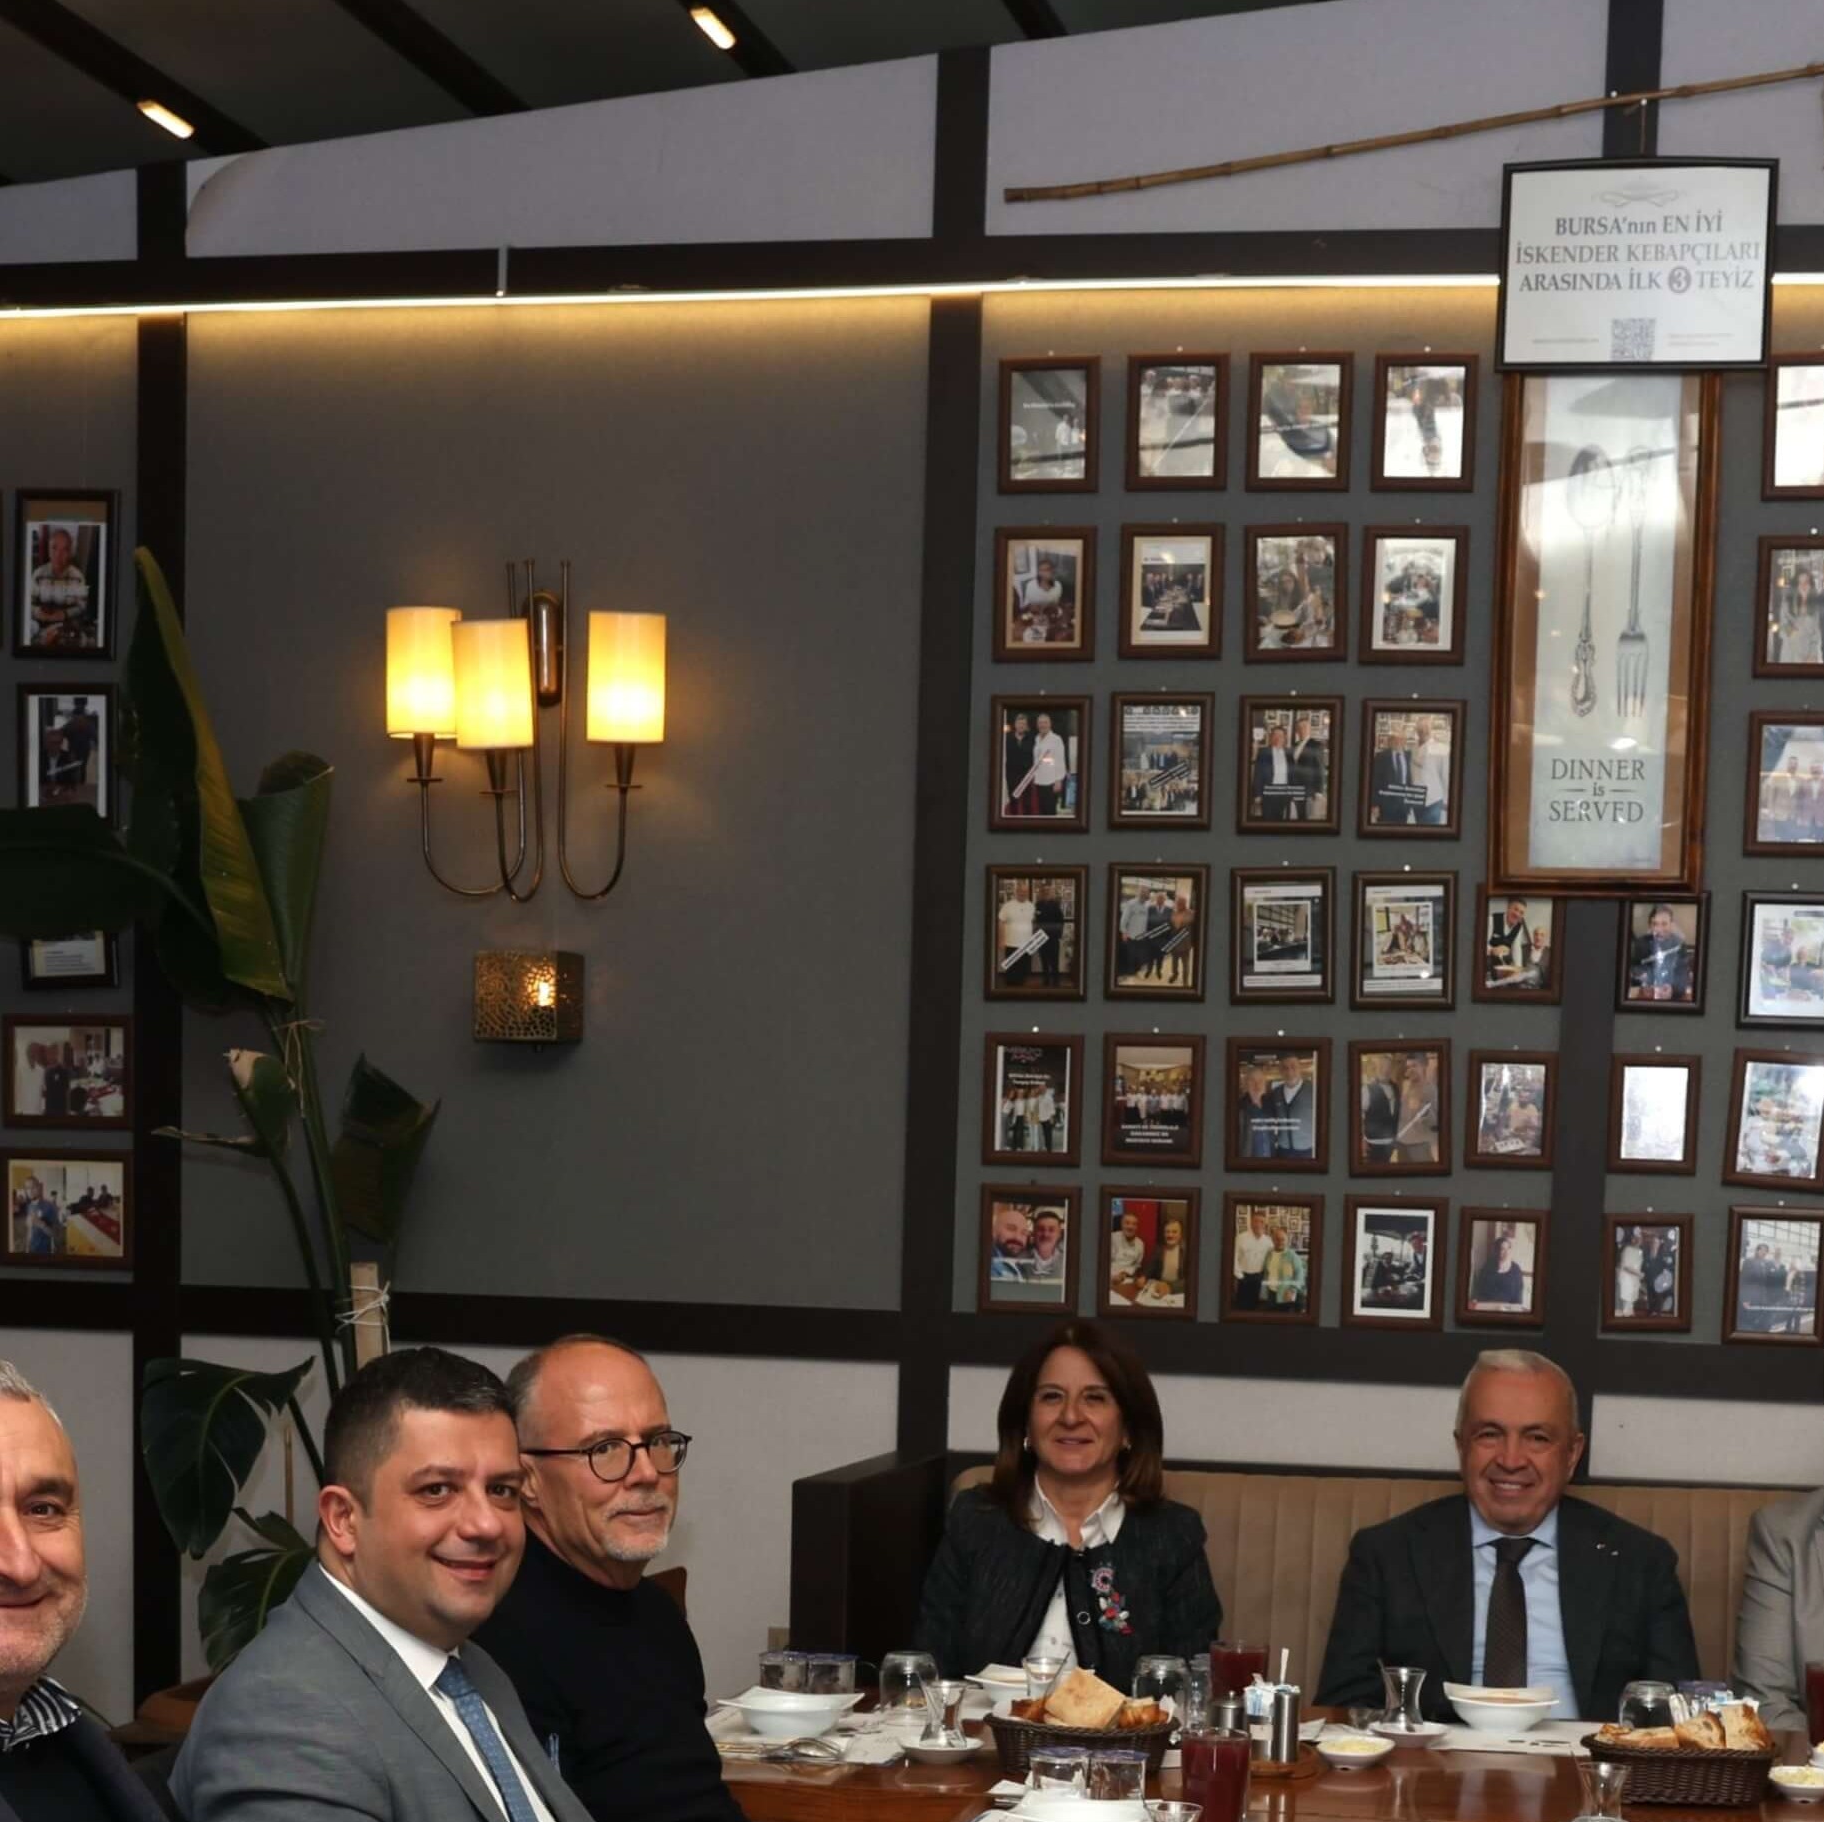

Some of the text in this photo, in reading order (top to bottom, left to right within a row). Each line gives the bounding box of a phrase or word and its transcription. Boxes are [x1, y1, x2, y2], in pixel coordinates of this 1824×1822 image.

[1662, 215, 1690, 233] EN
[1695, 210, 1723, 233] İYİ
[1516, 240, 1760, 265] İSKENDER KEBAPÇILARI
[1519, 272, 1622, 292] ARASINDA
[1628, 267, 1662, 290] İLK
[1697, 265, 1754, 289] TEYİZ
[1551, 758, 1645, 780] DINNER
[1592, 781, 1606, 797] is
[1549, 800, 1644, 822] SERVED
